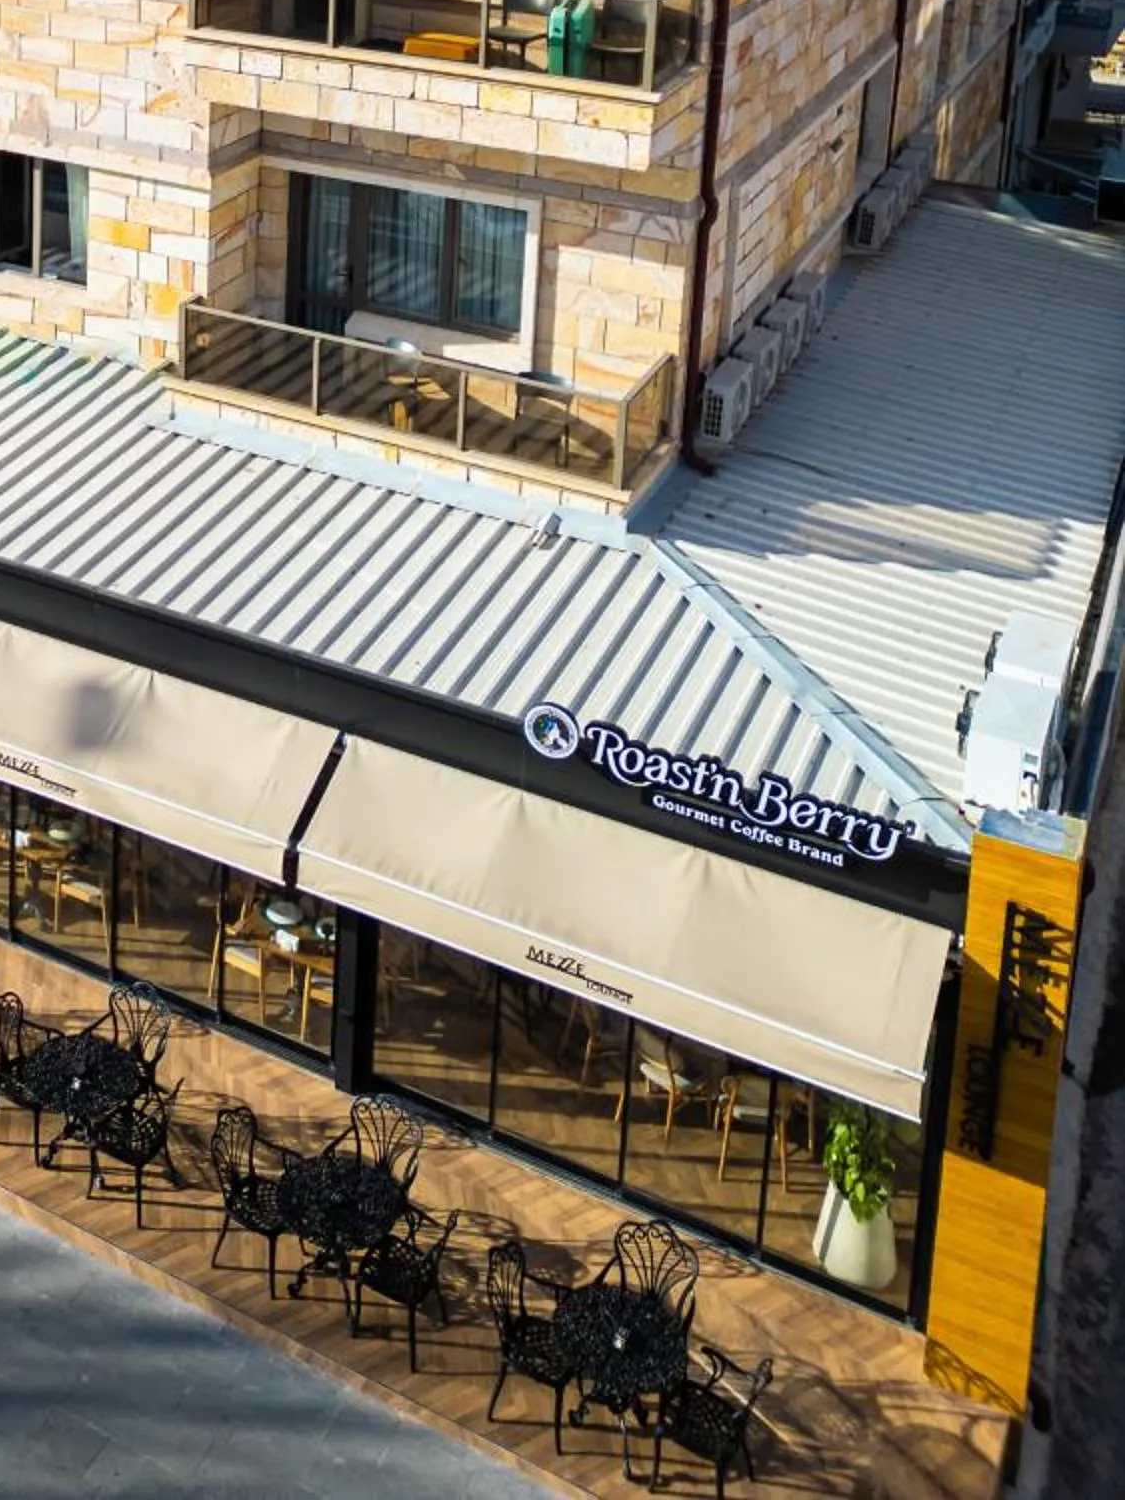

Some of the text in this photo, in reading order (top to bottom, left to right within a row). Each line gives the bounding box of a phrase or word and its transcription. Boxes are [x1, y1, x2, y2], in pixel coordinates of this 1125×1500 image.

[586, 726, 743, 807] Roast'n
[740, 776, 903, 861] Berry
[652, 795, 844, 867] Gourmet Coffee Brand
[526, 945, 585, 977] MEZZE
[959, 1043, 991, 1150] LOUNGE
